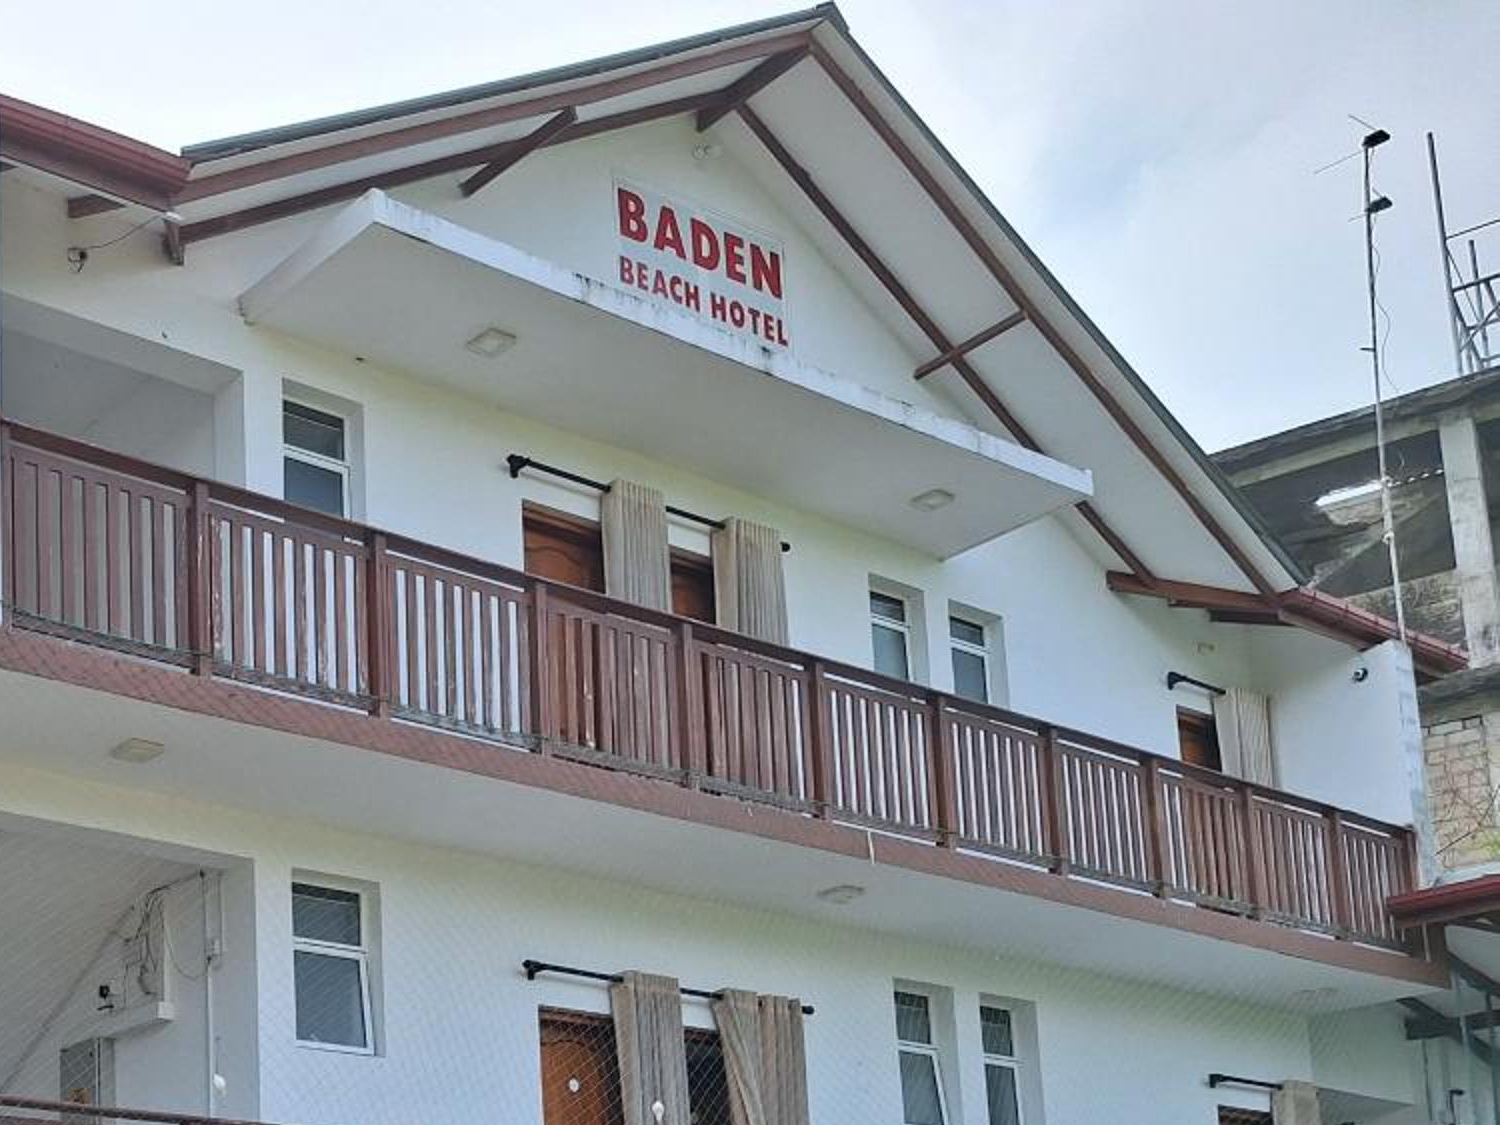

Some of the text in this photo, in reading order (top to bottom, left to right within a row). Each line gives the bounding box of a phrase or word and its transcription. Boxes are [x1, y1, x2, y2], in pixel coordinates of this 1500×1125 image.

[617, 187, 783, 300] BADEN
[619, 255, 789, 347] BEACH HOTEL
